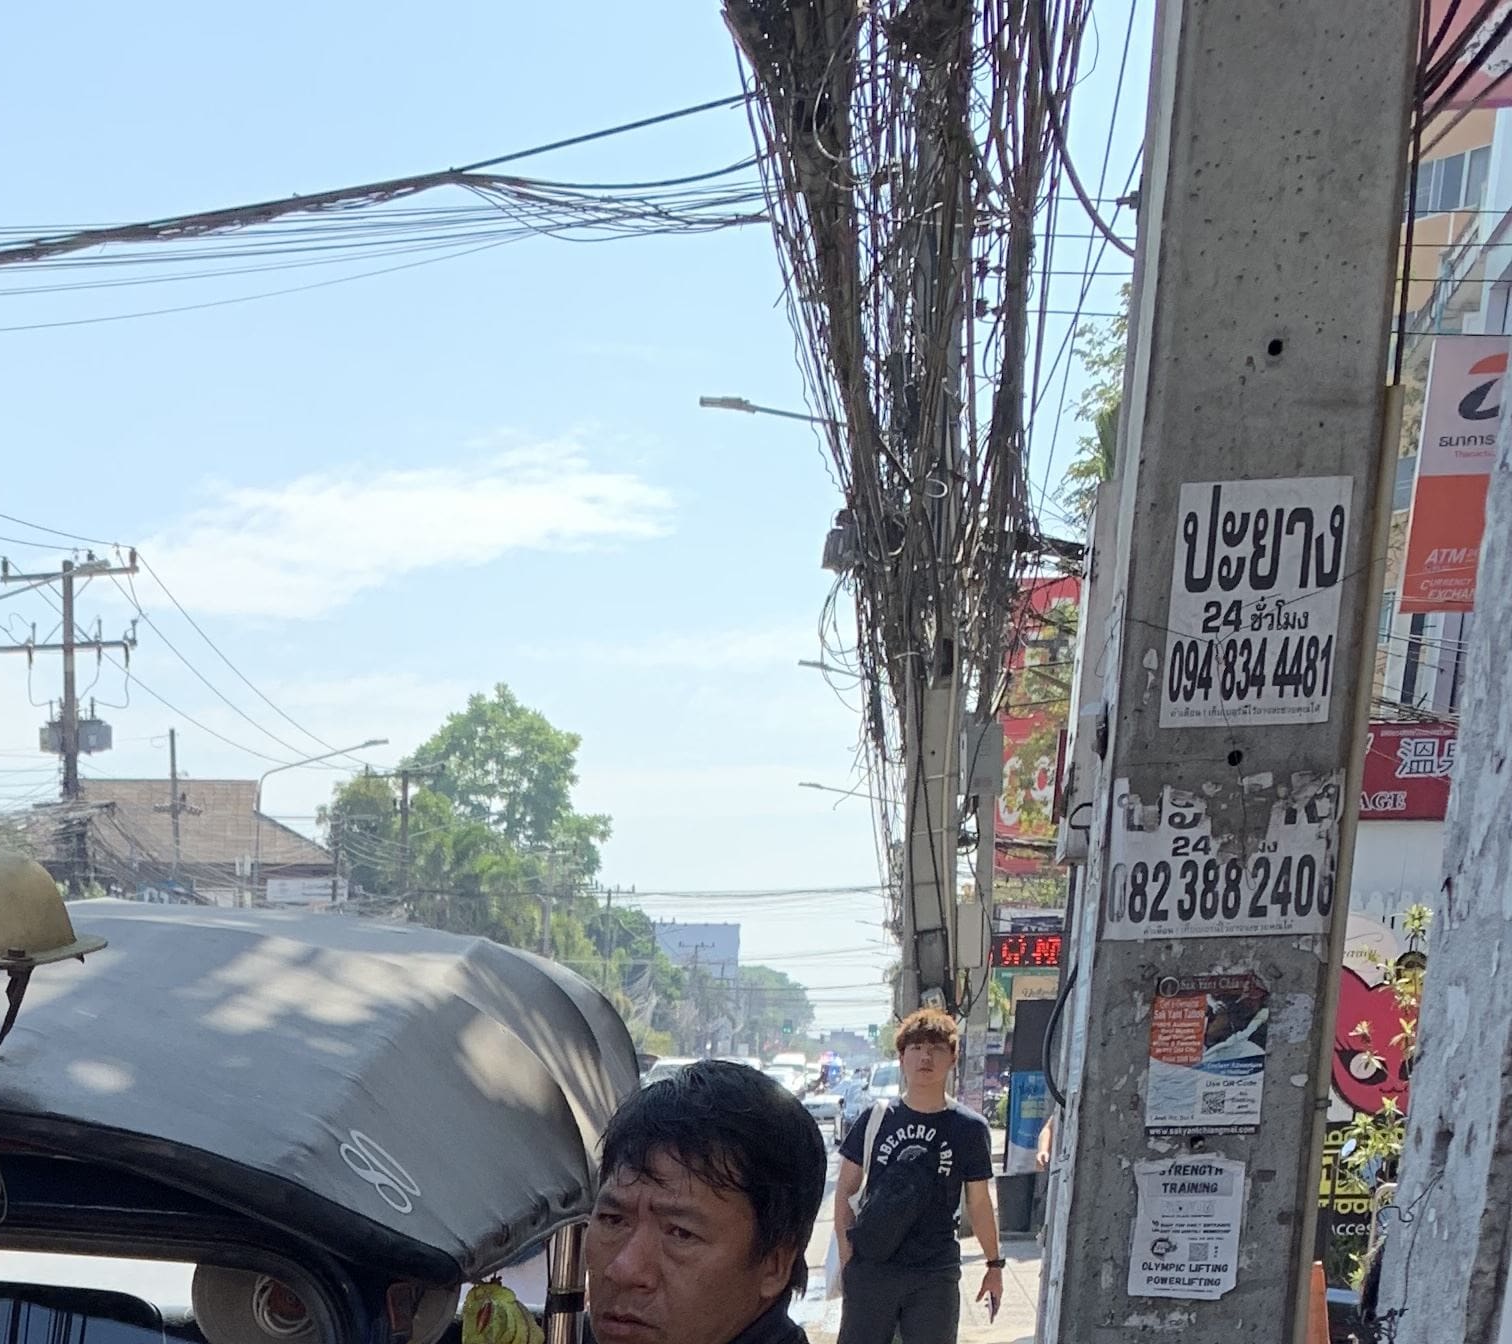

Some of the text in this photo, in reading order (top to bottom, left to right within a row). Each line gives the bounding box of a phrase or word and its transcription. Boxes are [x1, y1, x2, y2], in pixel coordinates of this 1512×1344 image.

[1184, 485, 1345, 593] ปะยาง
[1424, 547, 1467, 566] ATM
[1202, 596, 1309, 634] 24 ชั่วโมง
[1168, 633, 1334, 703] 094 834 4481
[1171, 835, 1212, 858] 24
[1177, 856, 1244, 922] 388
[339, 1129, 422, 1215] 80
[1161, 1182, 1219, 1195] TRAINING
[1141, 1261, 1229, 1274] OLYMPIC LIFTING
[1146, 1275, 1222, 1287] POWERLIFTING
